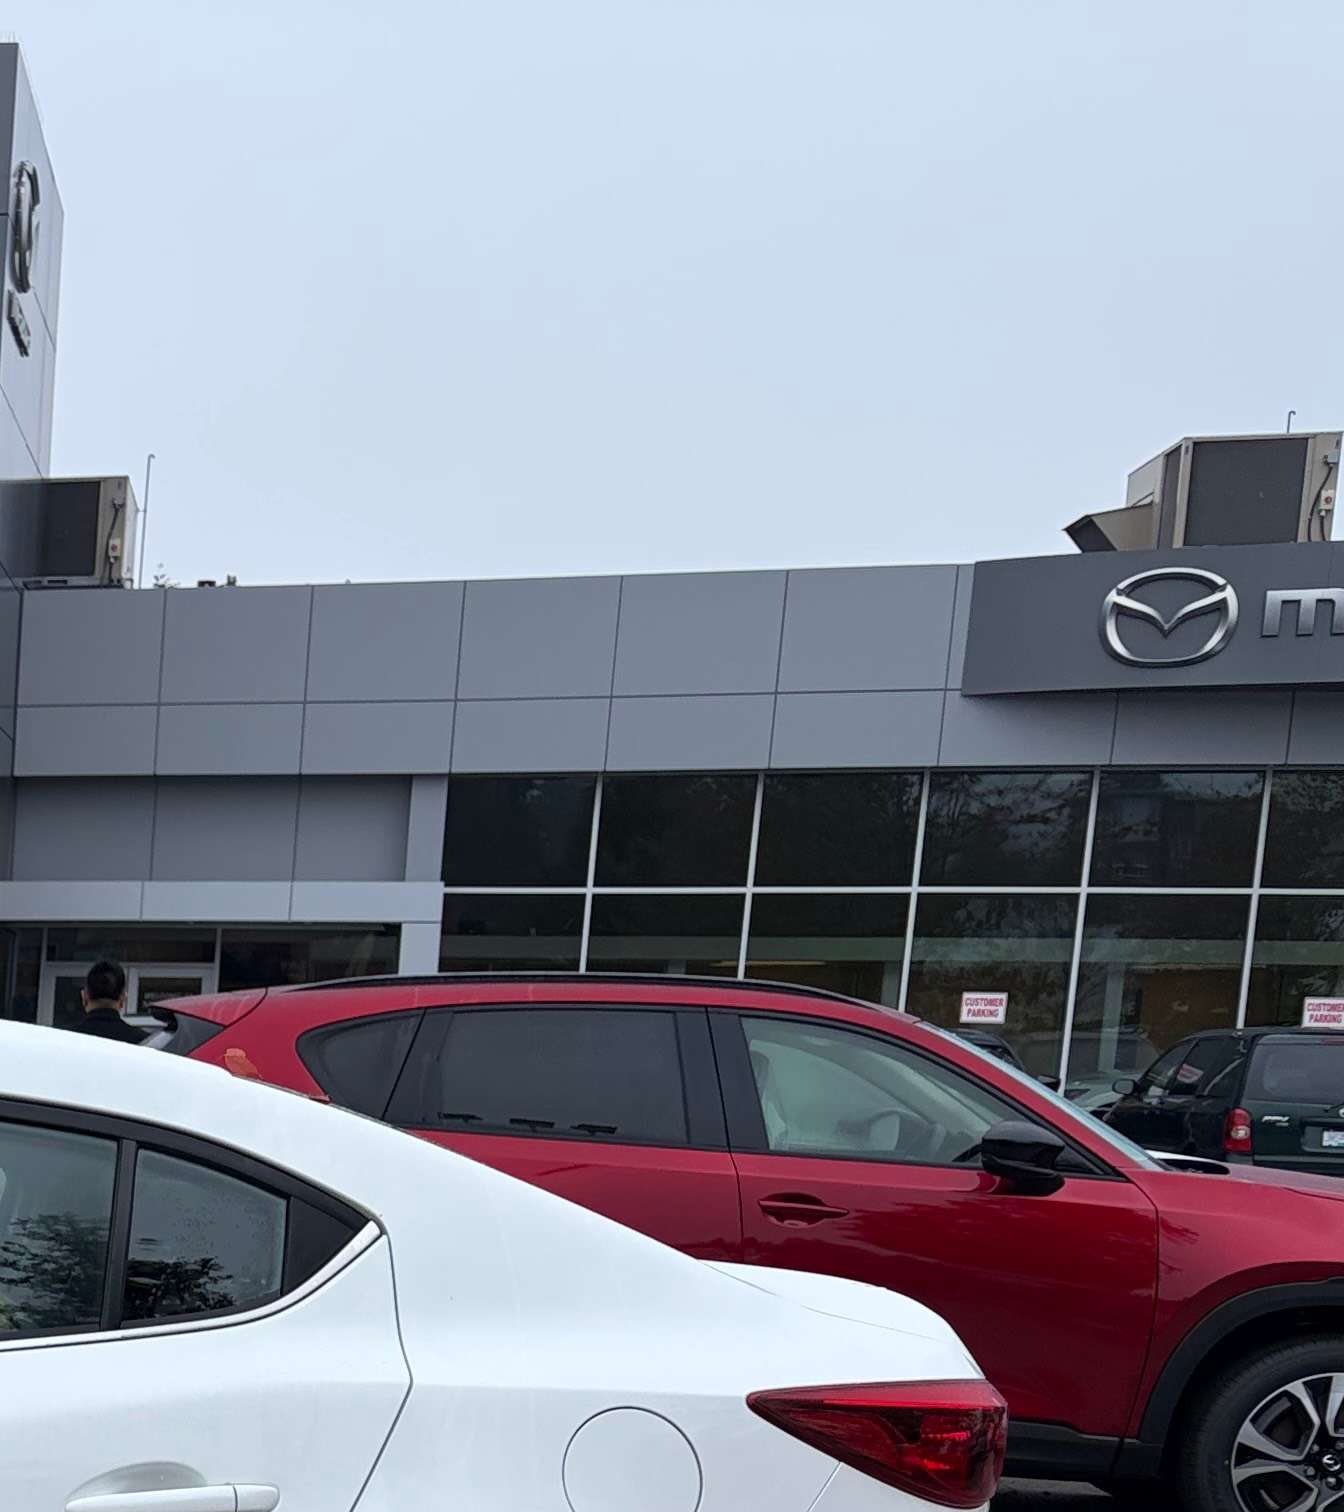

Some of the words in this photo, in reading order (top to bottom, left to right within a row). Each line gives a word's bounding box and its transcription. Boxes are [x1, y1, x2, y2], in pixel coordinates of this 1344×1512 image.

[964, 997, 1004, 1007] CUSTOMER
[967, 1008, 1000, 1018] PARKING
[1308, 1013, 1343, 1023] PARKING
